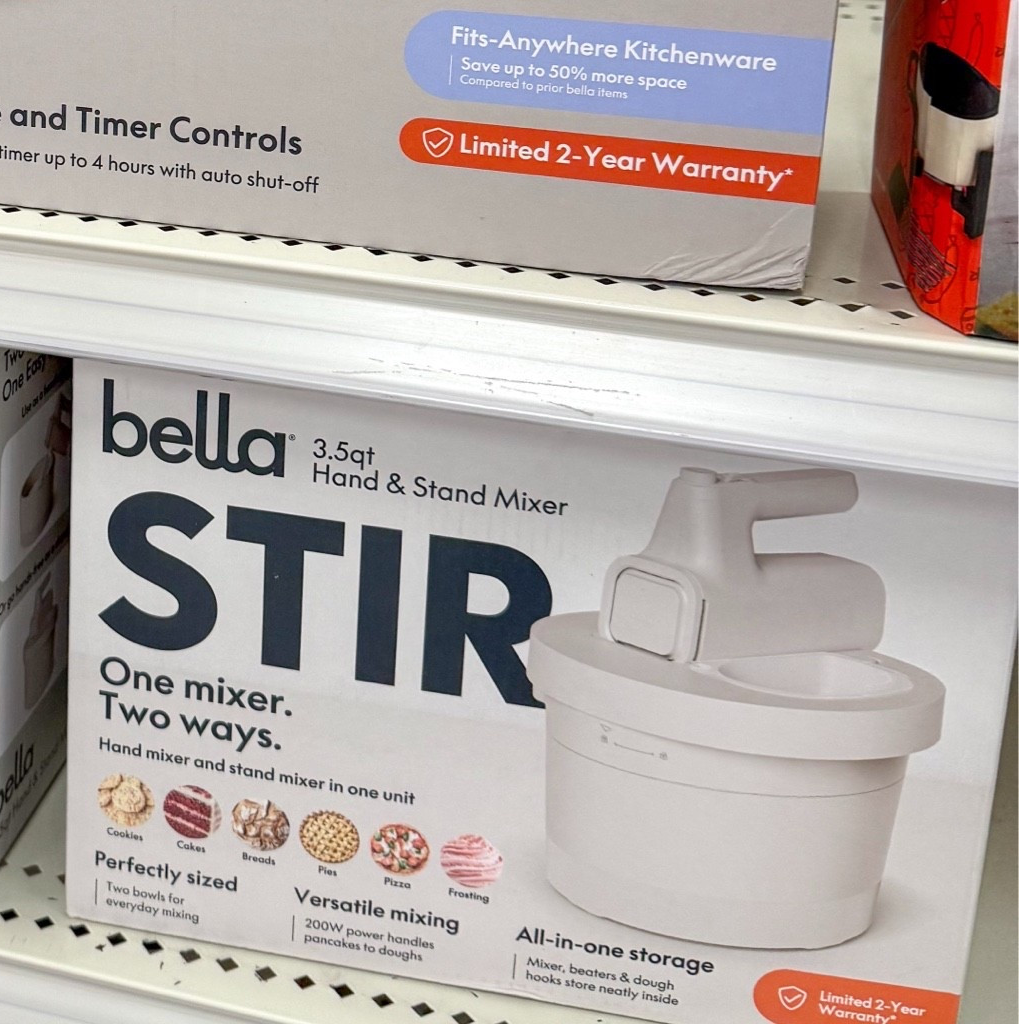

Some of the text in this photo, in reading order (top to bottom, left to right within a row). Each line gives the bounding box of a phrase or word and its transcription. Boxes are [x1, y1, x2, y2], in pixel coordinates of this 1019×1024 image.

[451, 25, 777, 72] Fits-Anywhere Kitchenware
[460, 75, 628, 99] Compared to prior bella items
[461, 57, 687, 91] Save up to 50% more space
[10, 104, 66, 131] and
[76, 107, 161, 139] Timer
[169, 116, 302, 155] Controls
[45, 154, 65, 169] up
[70, 152, 88, 168] to
[92, 155, 103, 170] 4
[109, 155, 155, 175] hours
[159, 162, 196, 180] with
[201, 169, 242, 185] auto
[246, 170, 319, 193] shut-off
[460, 134, 550, 163] Limited
[556, 144, 646, 172] 2-Year
[102, 378, 286, 477] bella
[312, 438, 375, 466] 3.5qt
[312, 463, 568, 516] Hand & Stand Mixer
[98, 491, 552, 709] STIR
[99, 656, 293, 717] One mixer.
[99, 690, 282, 753] Two ways.
[98, 736, 416, 806] Hand mixer and stand mixer in one unit
[95, 850, 238, 893] Perfectly sized
[107, 827, 490, 904] Cookies Cakes Breads Pies Pizza Frosting
[106, 881, 185, 906] Two bowls for
[106, 895, 200, 925] everyday mixing
[294, 886, 459, 935] Versatile mixing
[304, 933, 423, 962] pancakes to doughs
[305, 918, 435, 950] 200W power handles
[515, 927, 715, 975] All-in-one storage
[526, 970, 679, 1006] hooks store neatly inside
[527, 957, 675, 992] Mixer, beaters & dough
[819, 990, 927, 1016] Limited 2-Year
